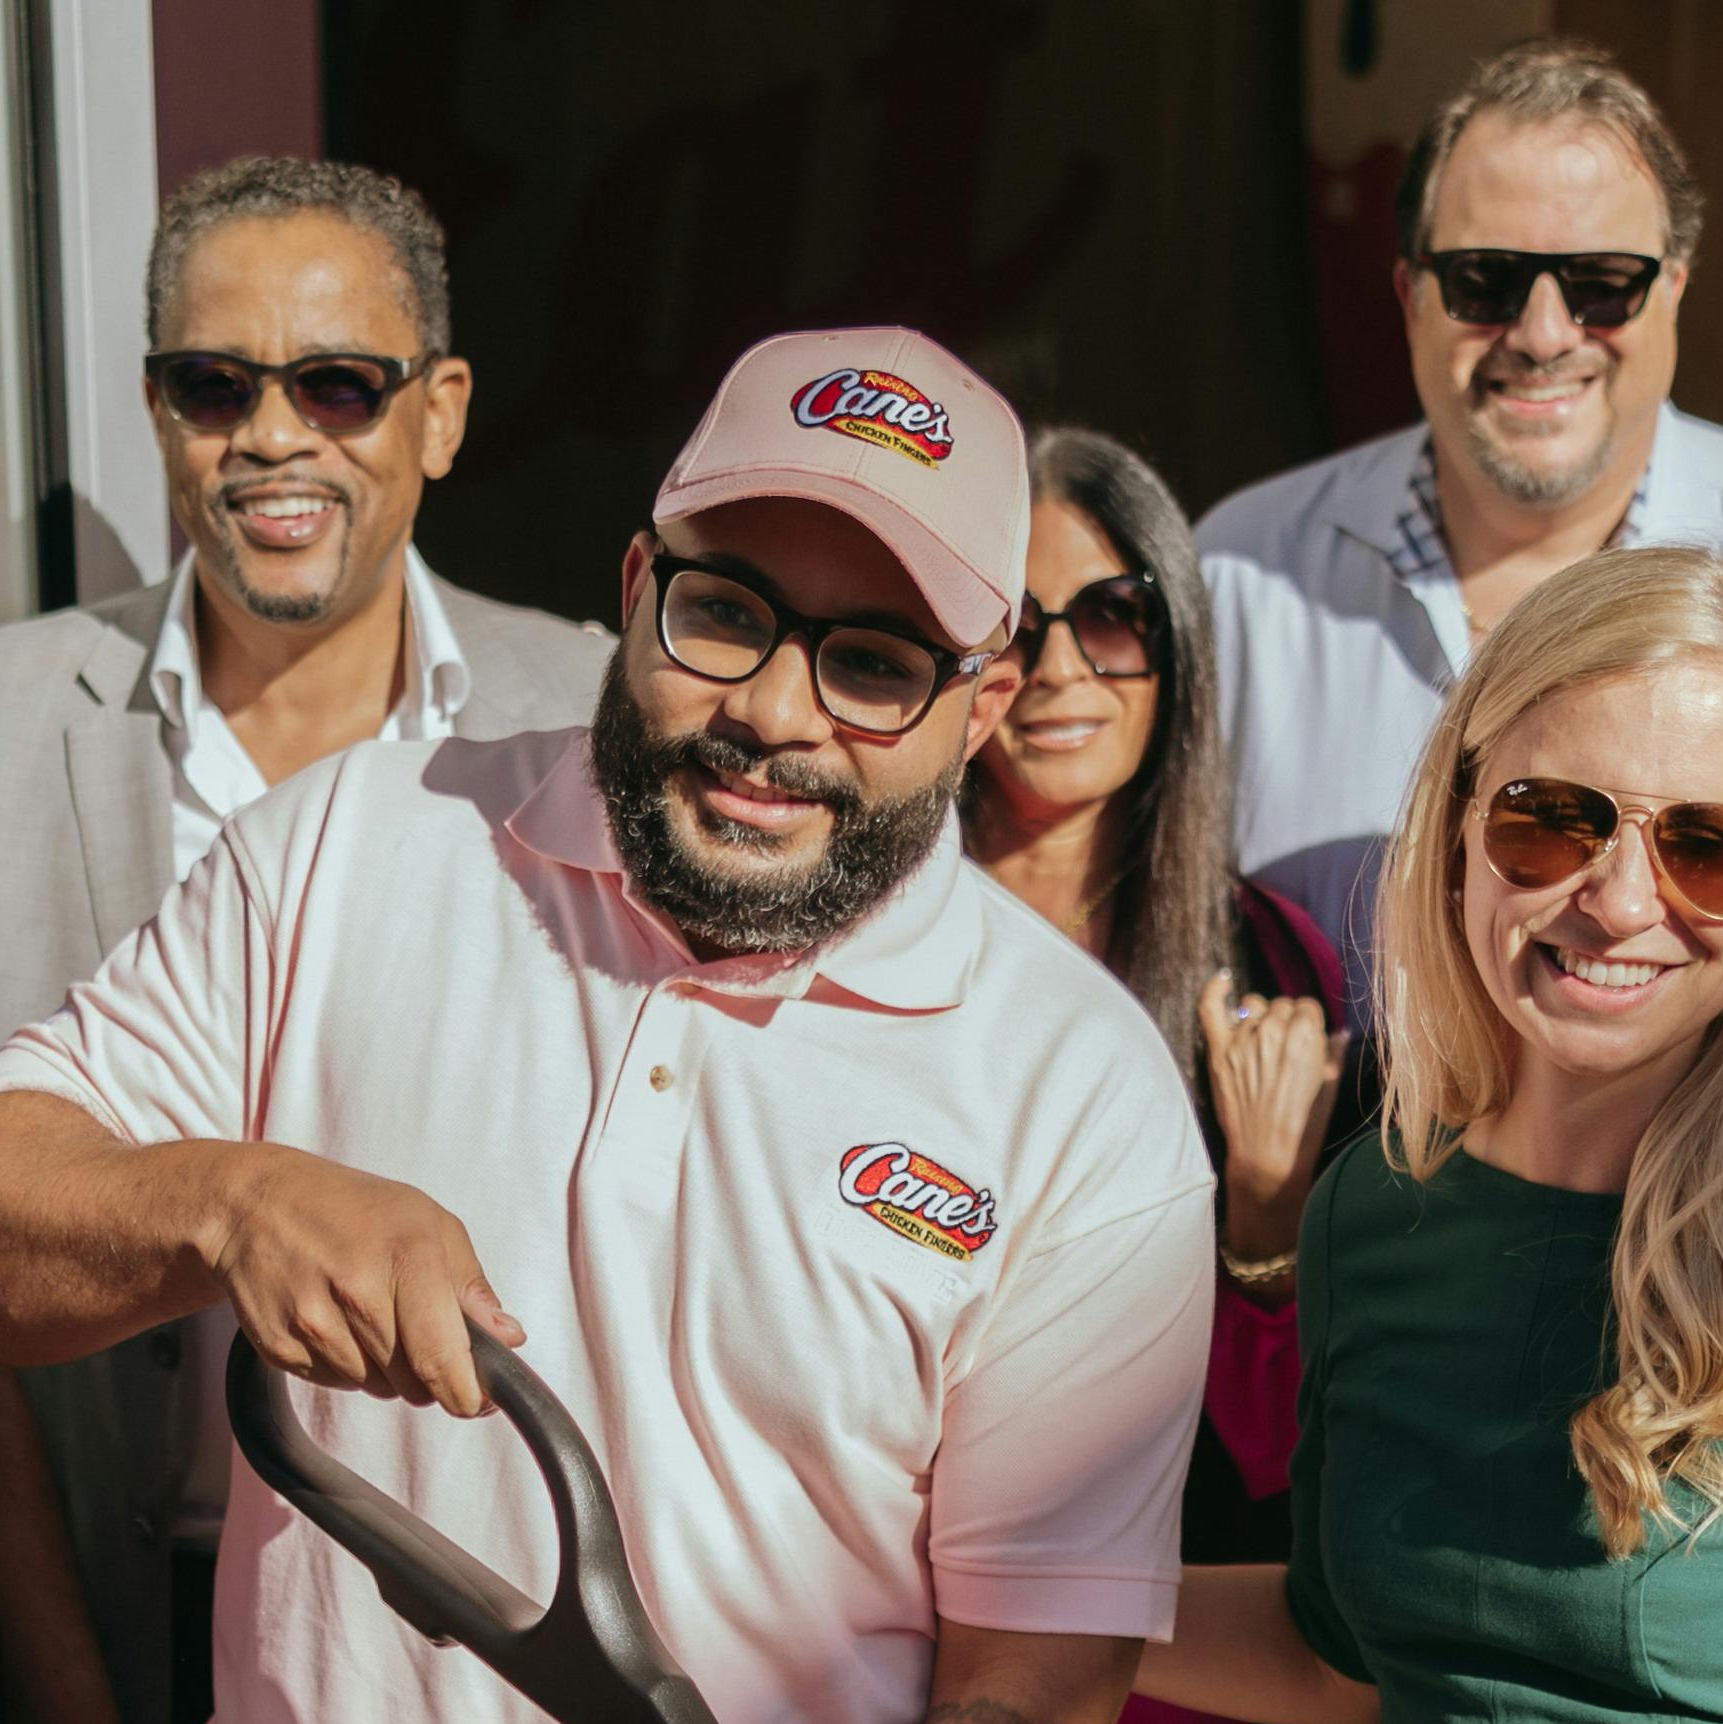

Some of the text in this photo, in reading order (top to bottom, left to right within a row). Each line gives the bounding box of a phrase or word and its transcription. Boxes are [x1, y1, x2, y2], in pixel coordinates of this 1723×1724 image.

[796, 368, 954, 443] Cane's
[846, 421, 891, 444] CHICKEN
[839, 1142, 997, 1234] Cane's
[880, 1206, 922, 1236] CHICKEN
